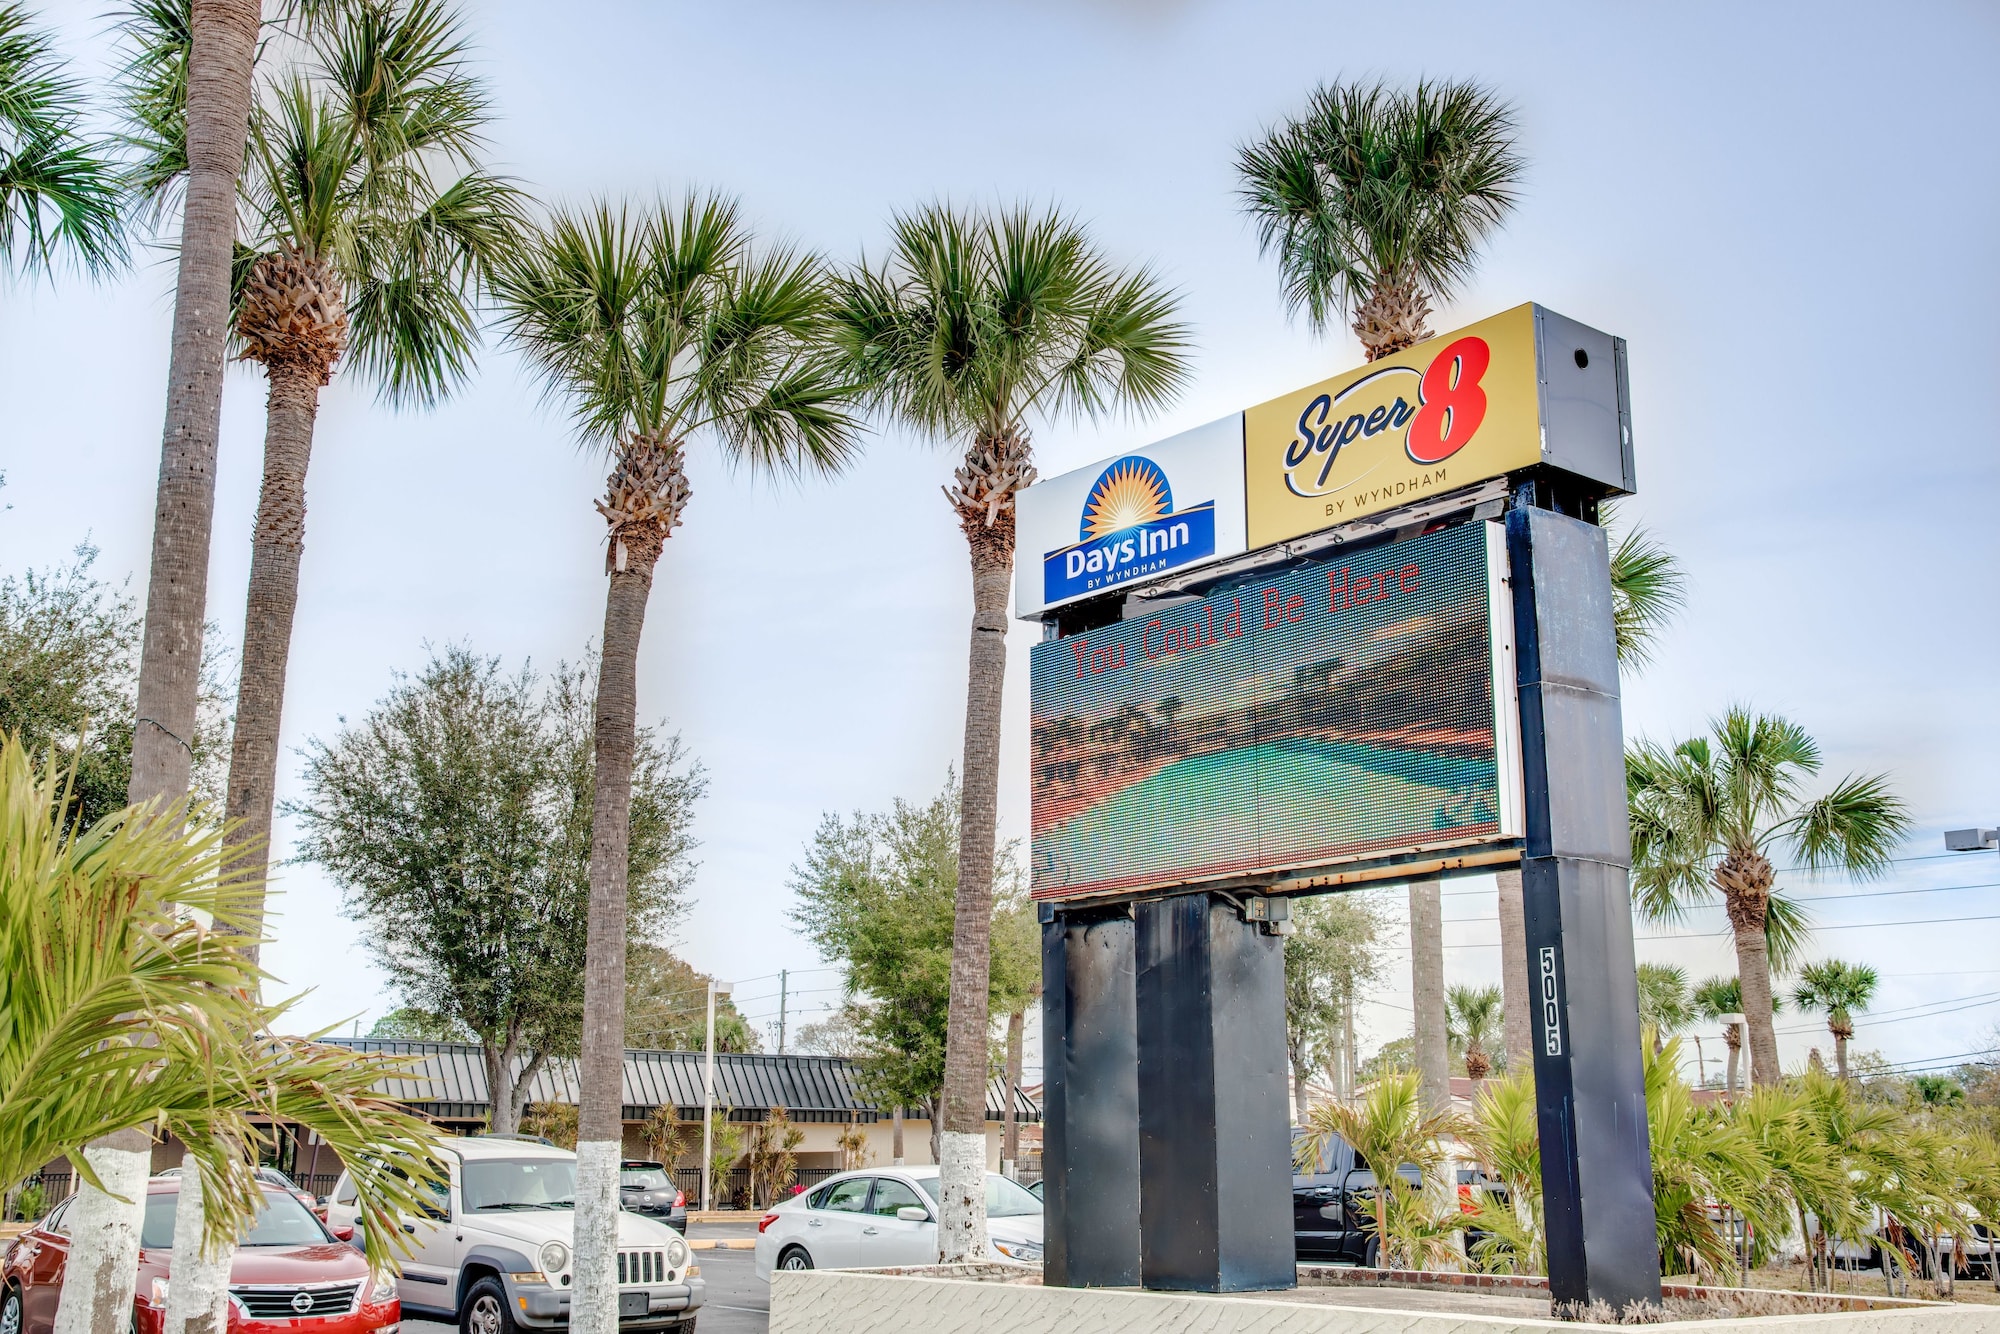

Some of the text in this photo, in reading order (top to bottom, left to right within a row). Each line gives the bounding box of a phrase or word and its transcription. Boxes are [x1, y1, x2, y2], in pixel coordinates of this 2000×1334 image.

[1283, 336, 1490, 489] Super 8
[1325, 468, 1447, 517] BY WYNDHAM
[1066, 522, 1190, 580] Days Inn
[1087, 558, 1167, 589] BY WYNDHAM
[1072, 563, 1421, 679] You Could Be Here
[1541, 948, 1559, 1055] 5005
